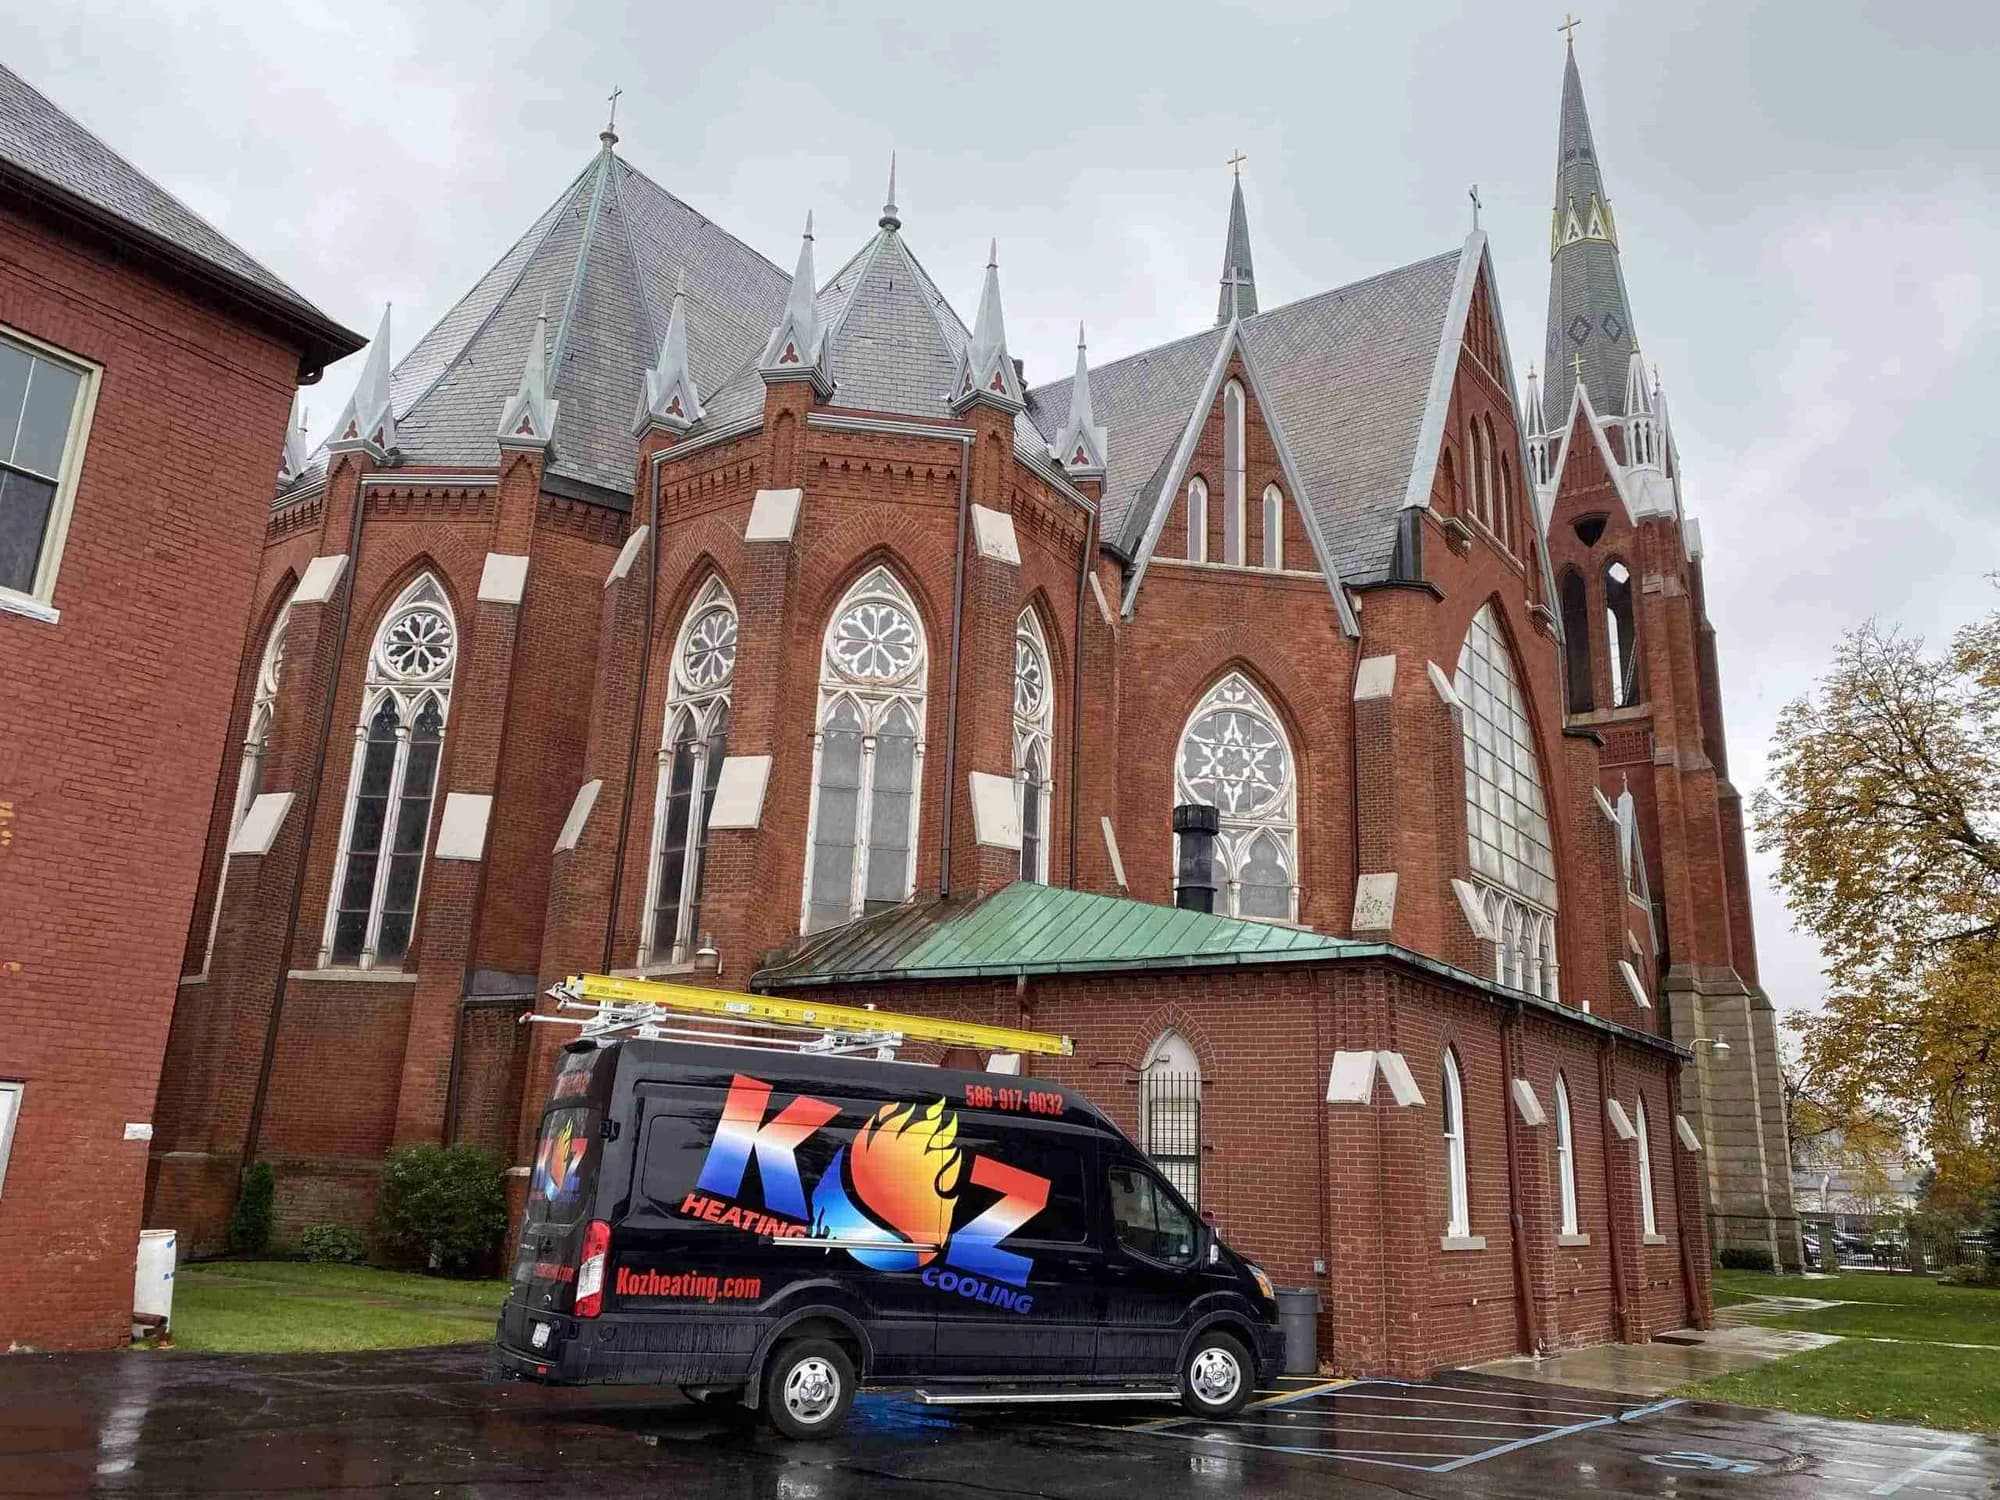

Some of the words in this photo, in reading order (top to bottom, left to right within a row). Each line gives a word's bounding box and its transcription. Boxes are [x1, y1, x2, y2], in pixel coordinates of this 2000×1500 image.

[680, 1193, 807, 1238] HEATING
[615, 1267, 761, 1304] Kozheating.com
[921, 1267, 1034, 1314] COOLING
